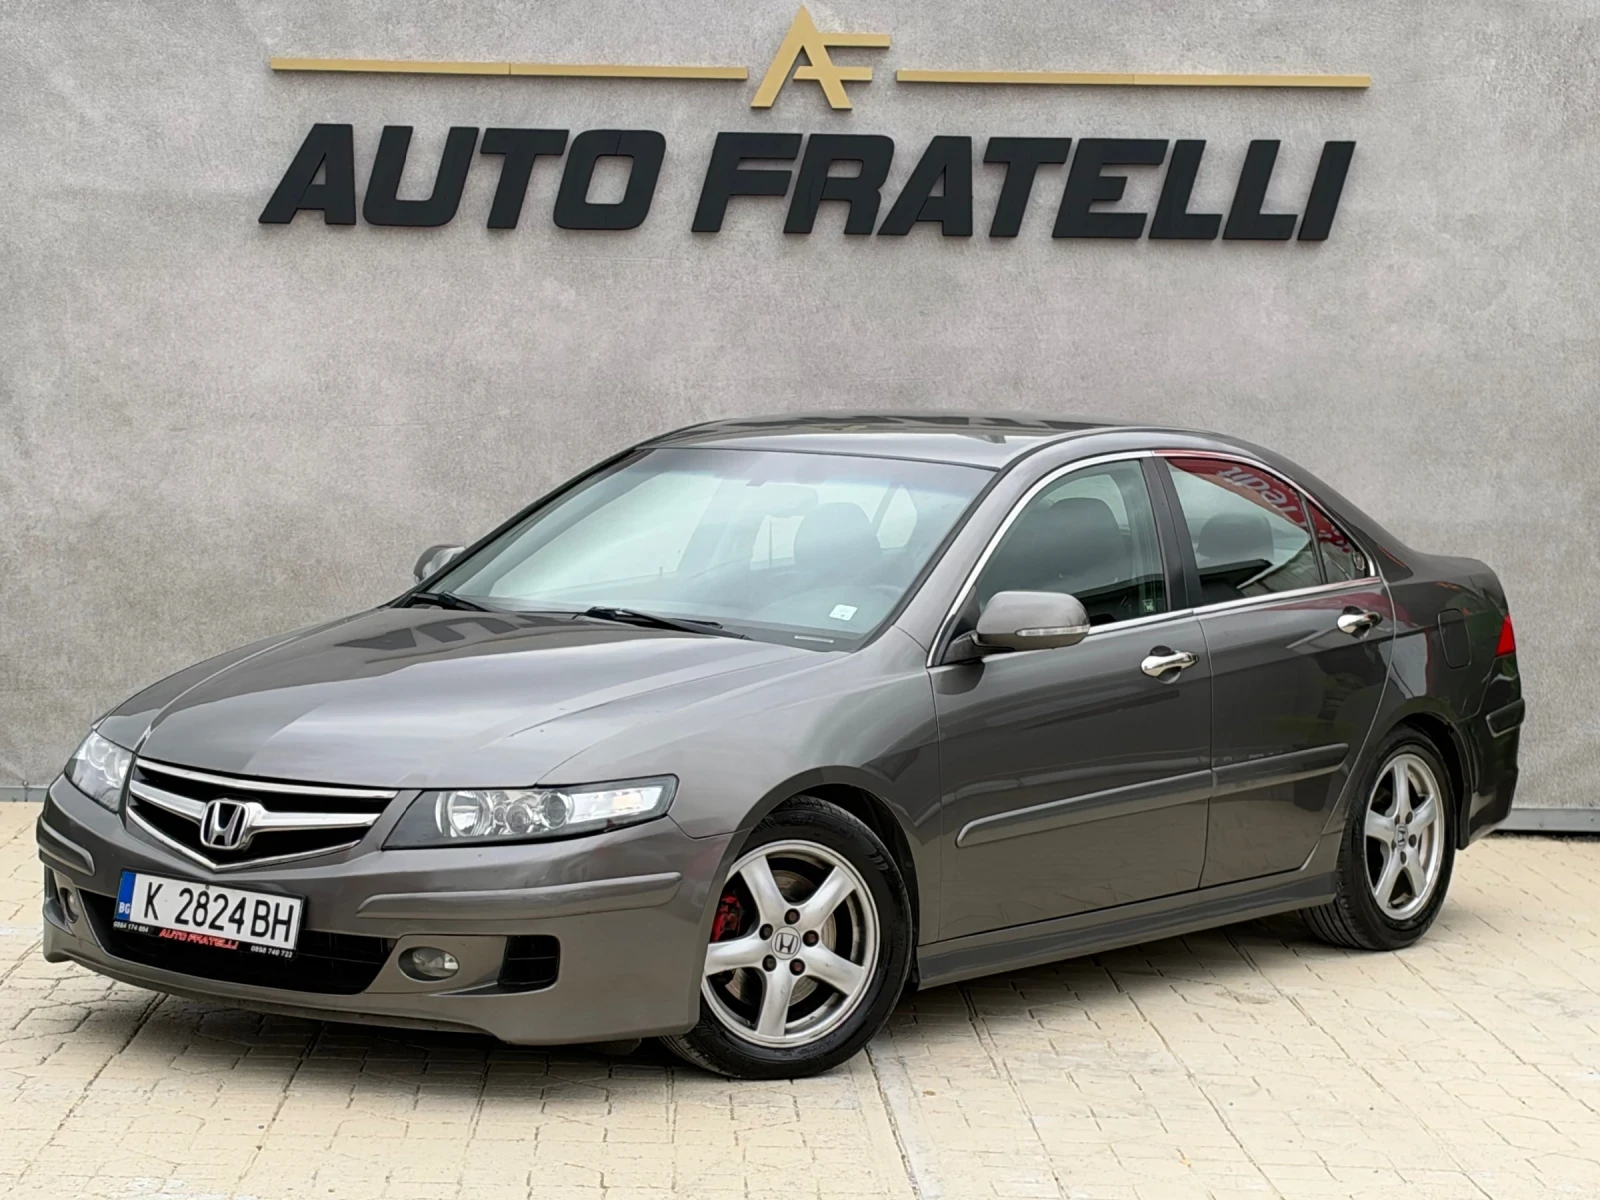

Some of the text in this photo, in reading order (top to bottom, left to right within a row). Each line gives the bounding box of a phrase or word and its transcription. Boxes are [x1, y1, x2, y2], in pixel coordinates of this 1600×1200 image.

[258, 124, 1357, 243] AUTO FRATELLI
[117, 901, 131, 914] BG
[143, 881, 164, 921] K
[158, 928, 188, 942] AUTO
